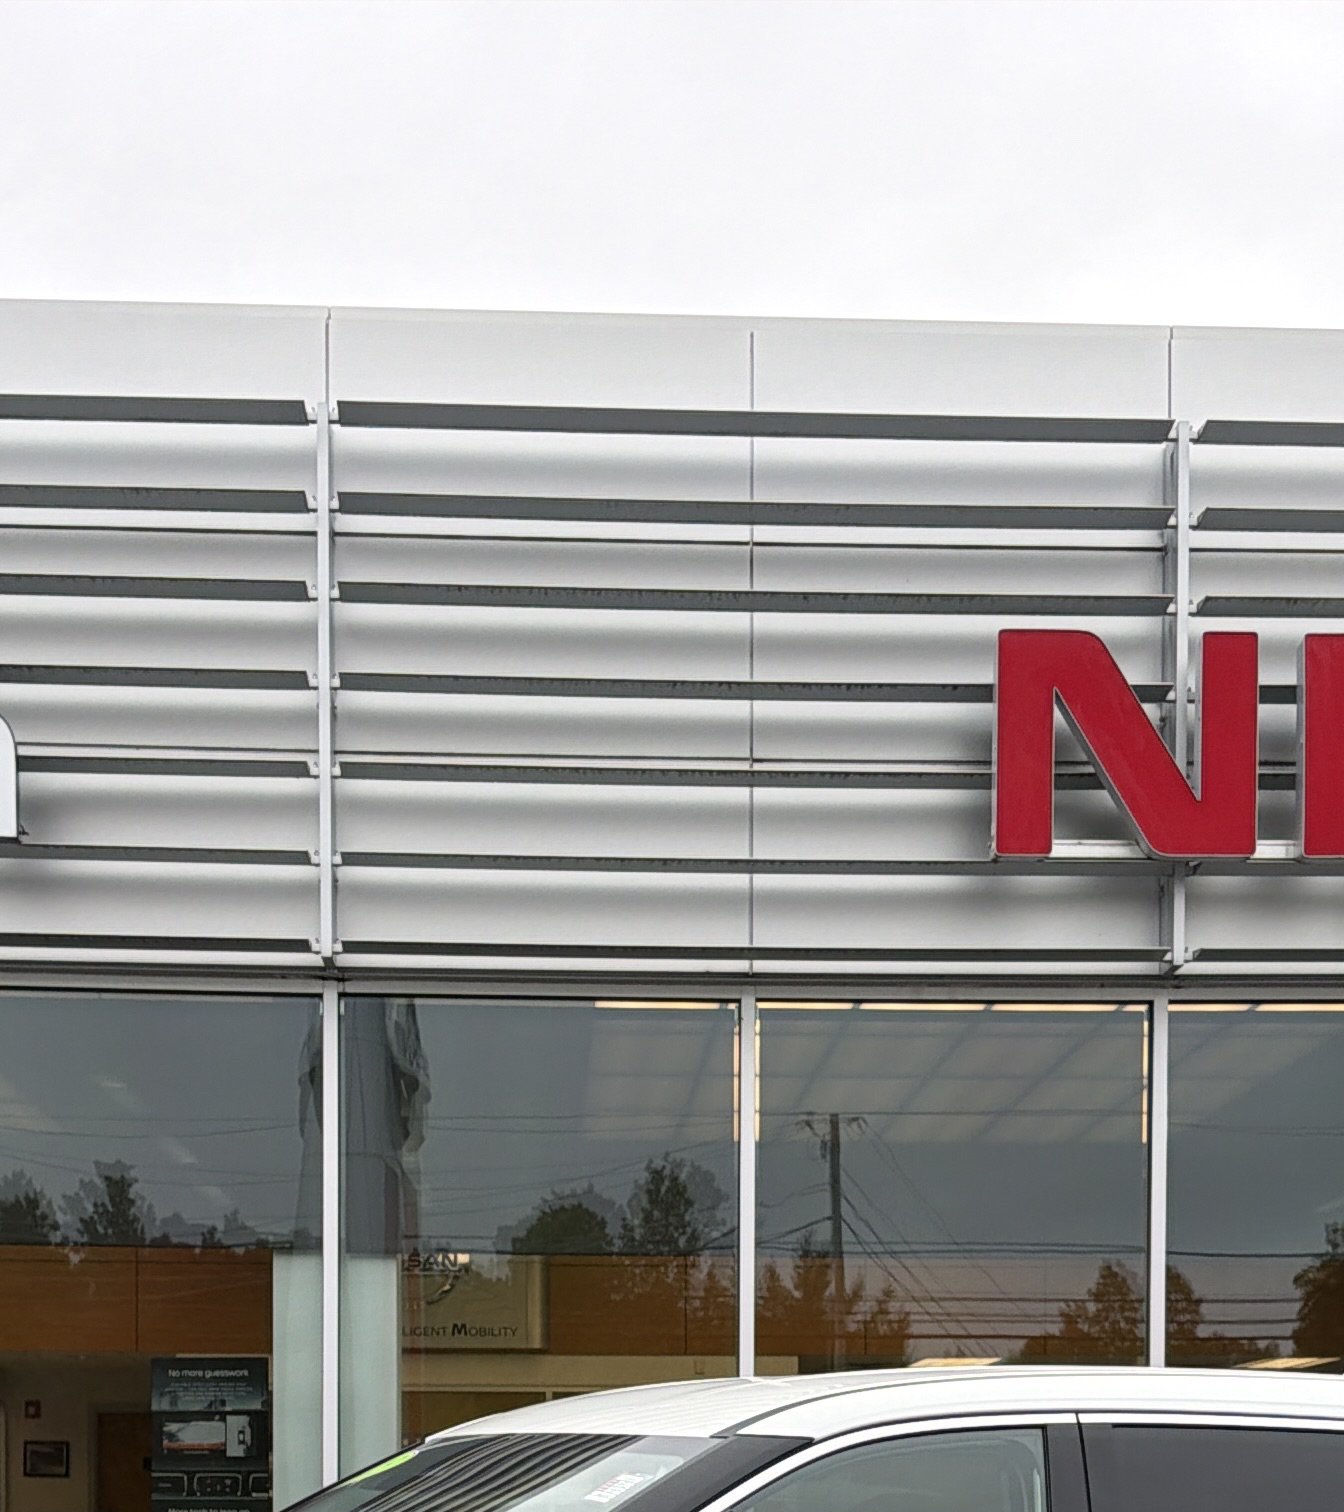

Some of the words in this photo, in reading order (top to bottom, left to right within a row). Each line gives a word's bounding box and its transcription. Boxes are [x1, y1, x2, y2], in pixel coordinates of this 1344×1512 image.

[402, 1253, 458, 1268] SAN
[402, 1327, 447, 1337] LIGENT
[168, 1369, 181, 1377] No
[205, 1369, 249, 1379] guesswork
